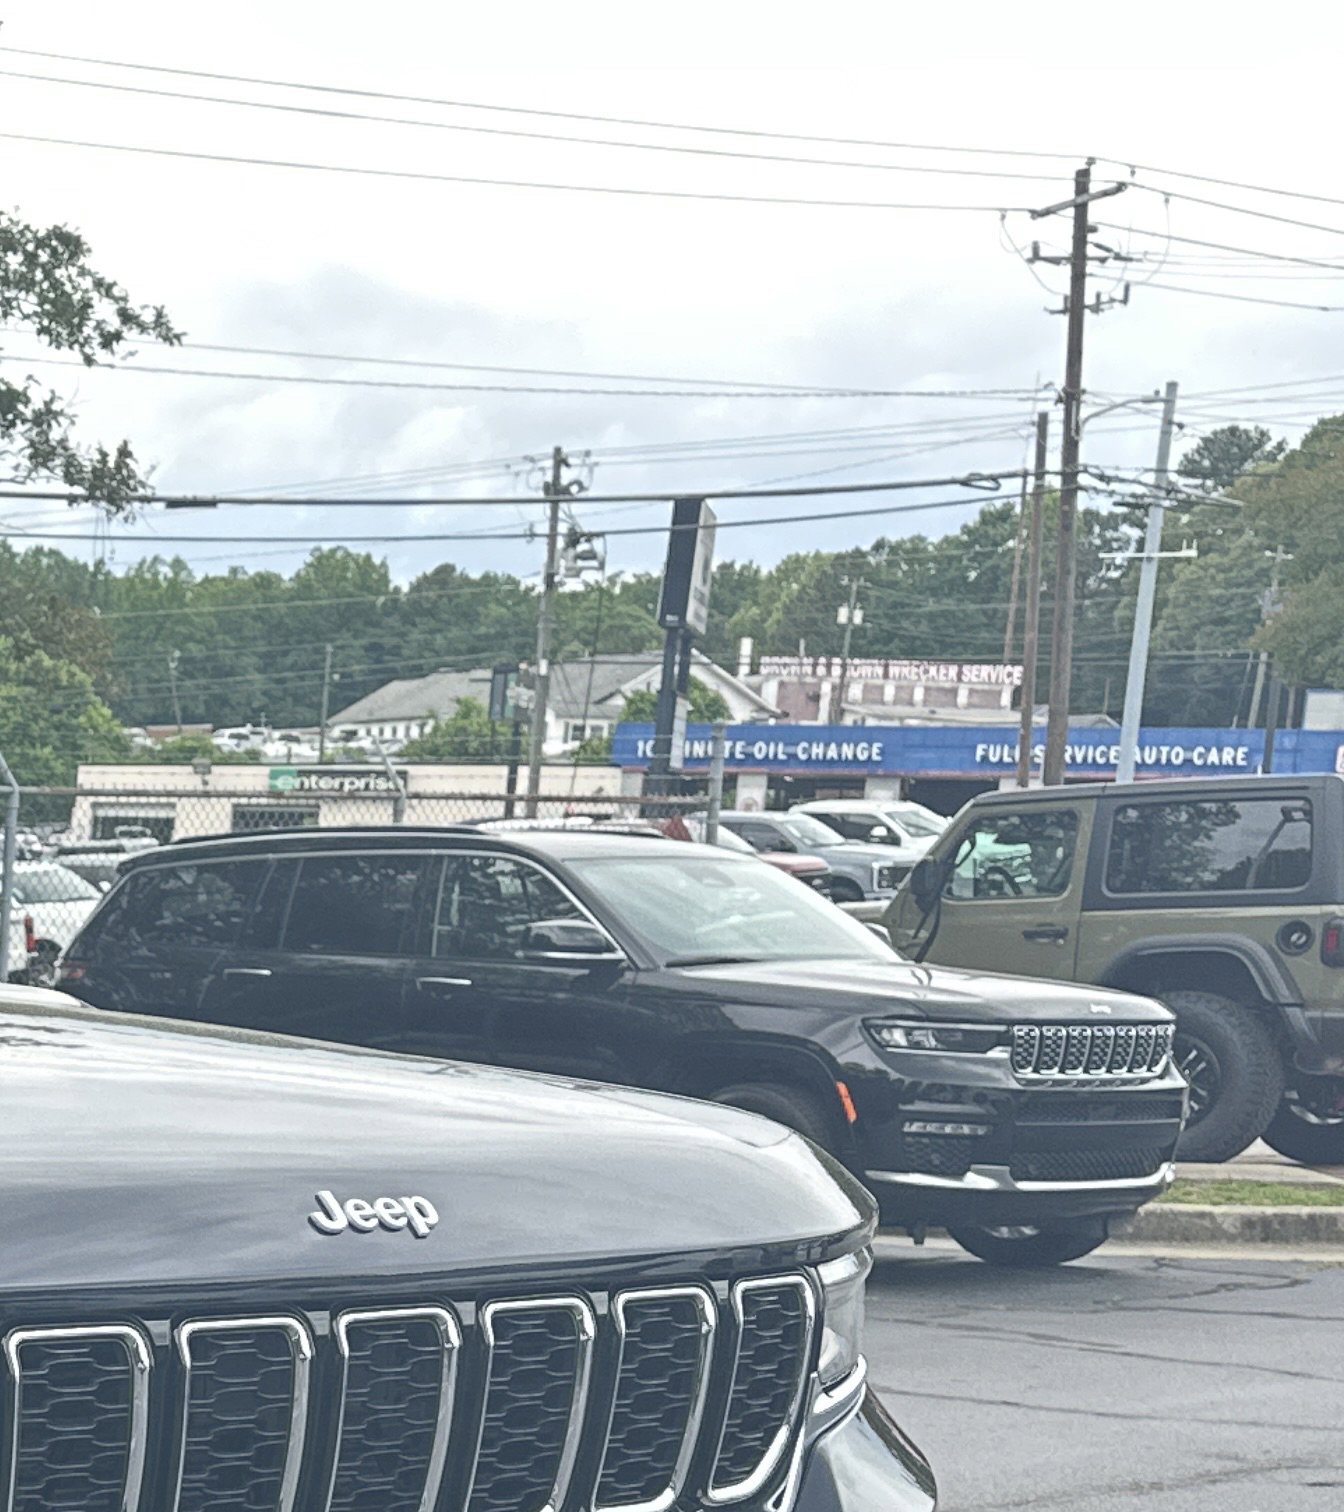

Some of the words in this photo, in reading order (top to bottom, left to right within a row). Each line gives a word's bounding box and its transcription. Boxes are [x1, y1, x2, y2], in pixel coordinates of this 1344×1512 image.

[961, 664, 1024, 686] SERVICE
[753, 741, 787, 760] OIL
[796, 741, 884, 761] CHANGE
[1033, 744, 1121, 765] SRVICE
[1192, 745, 1248, 766] CARE
[308, 1190, 439, 1237] Jeep
